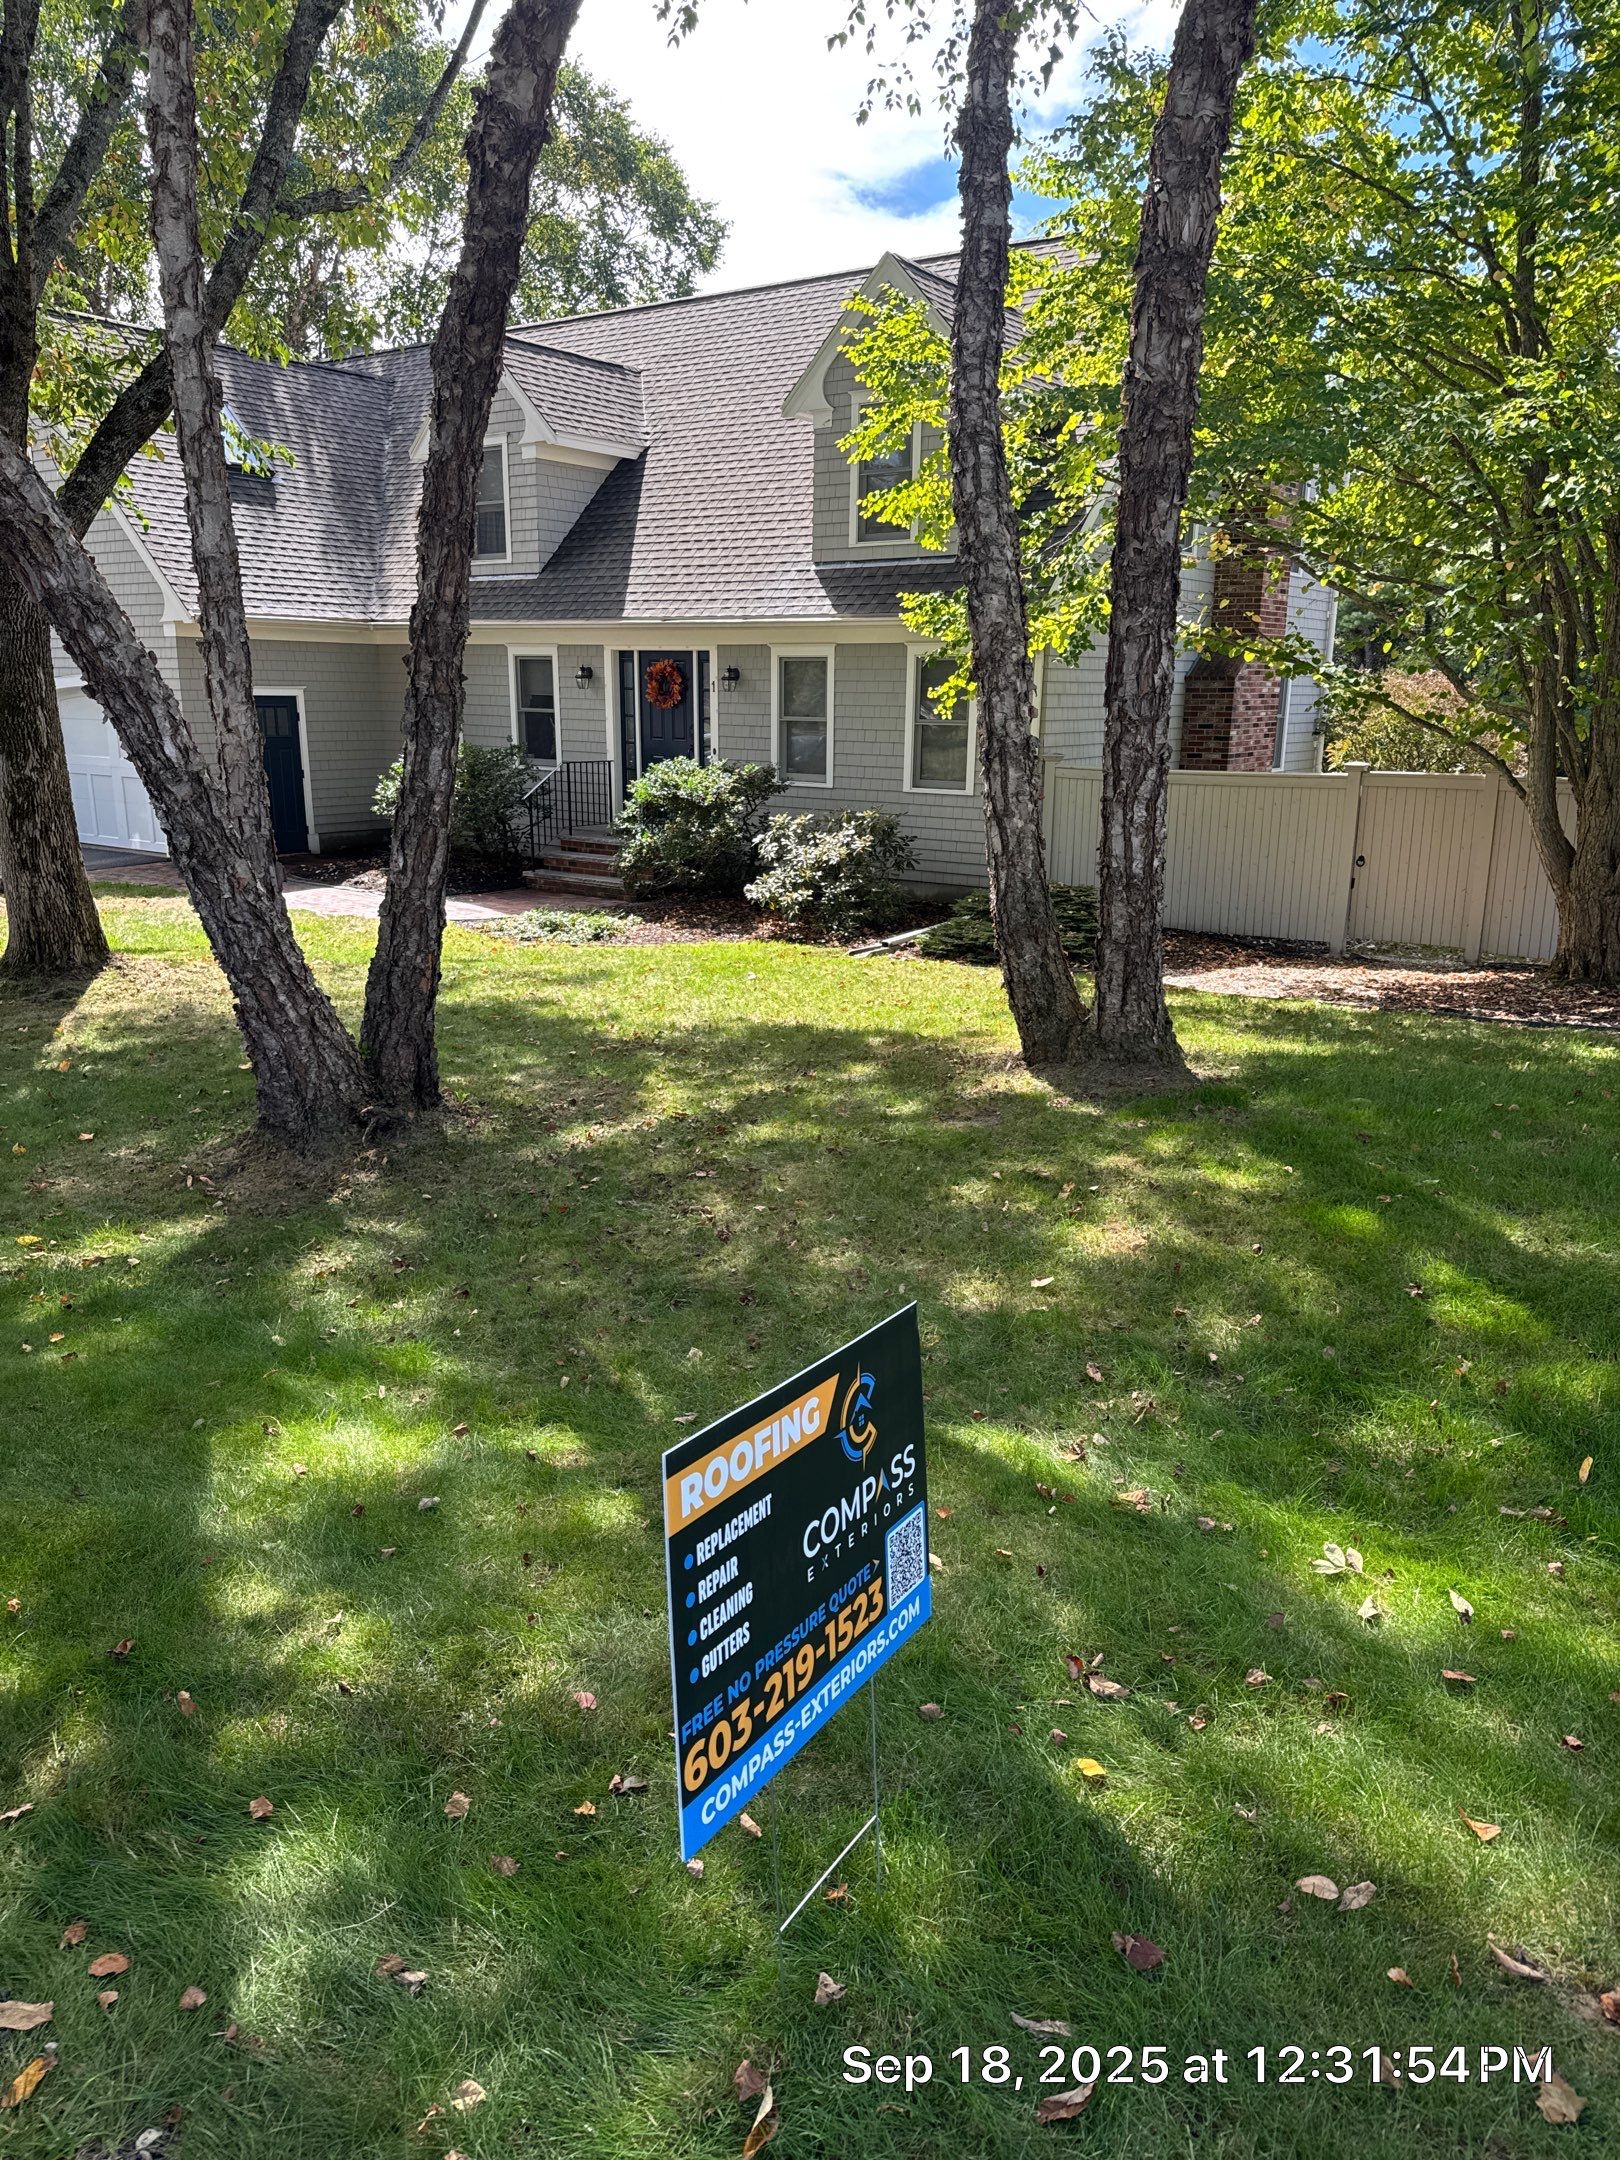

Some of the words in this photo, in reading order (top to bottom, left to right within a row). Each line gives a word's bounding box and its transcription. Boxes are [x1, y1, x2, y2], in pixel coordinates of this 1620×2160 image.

[680, 1396, 820, 1519] ROOFING
[802, 1443, 916, 1559] COMPASS
[696, 1493, 773, 1567] REPLACEMENT
[697, 1556, 739, 1604] REPAIR
[806, 1483, 915, 1583] EXTERIORS
[681, 1692, 723, 1745] FREE
[728, 1671, 751, 1702] NO
[754, 1602, 827, 1681] PRESSURE
[828, 1562, 871, 1613] QUOTE
[700, 1581, 754, 1641] CLEANING
[701, 1621, 751, 1679] GUTTERS
[683, 1576, 884, 1793] 603-219-1523
[701, 1595, 921, 1826] COMPASS-EXTERIORS.COM
